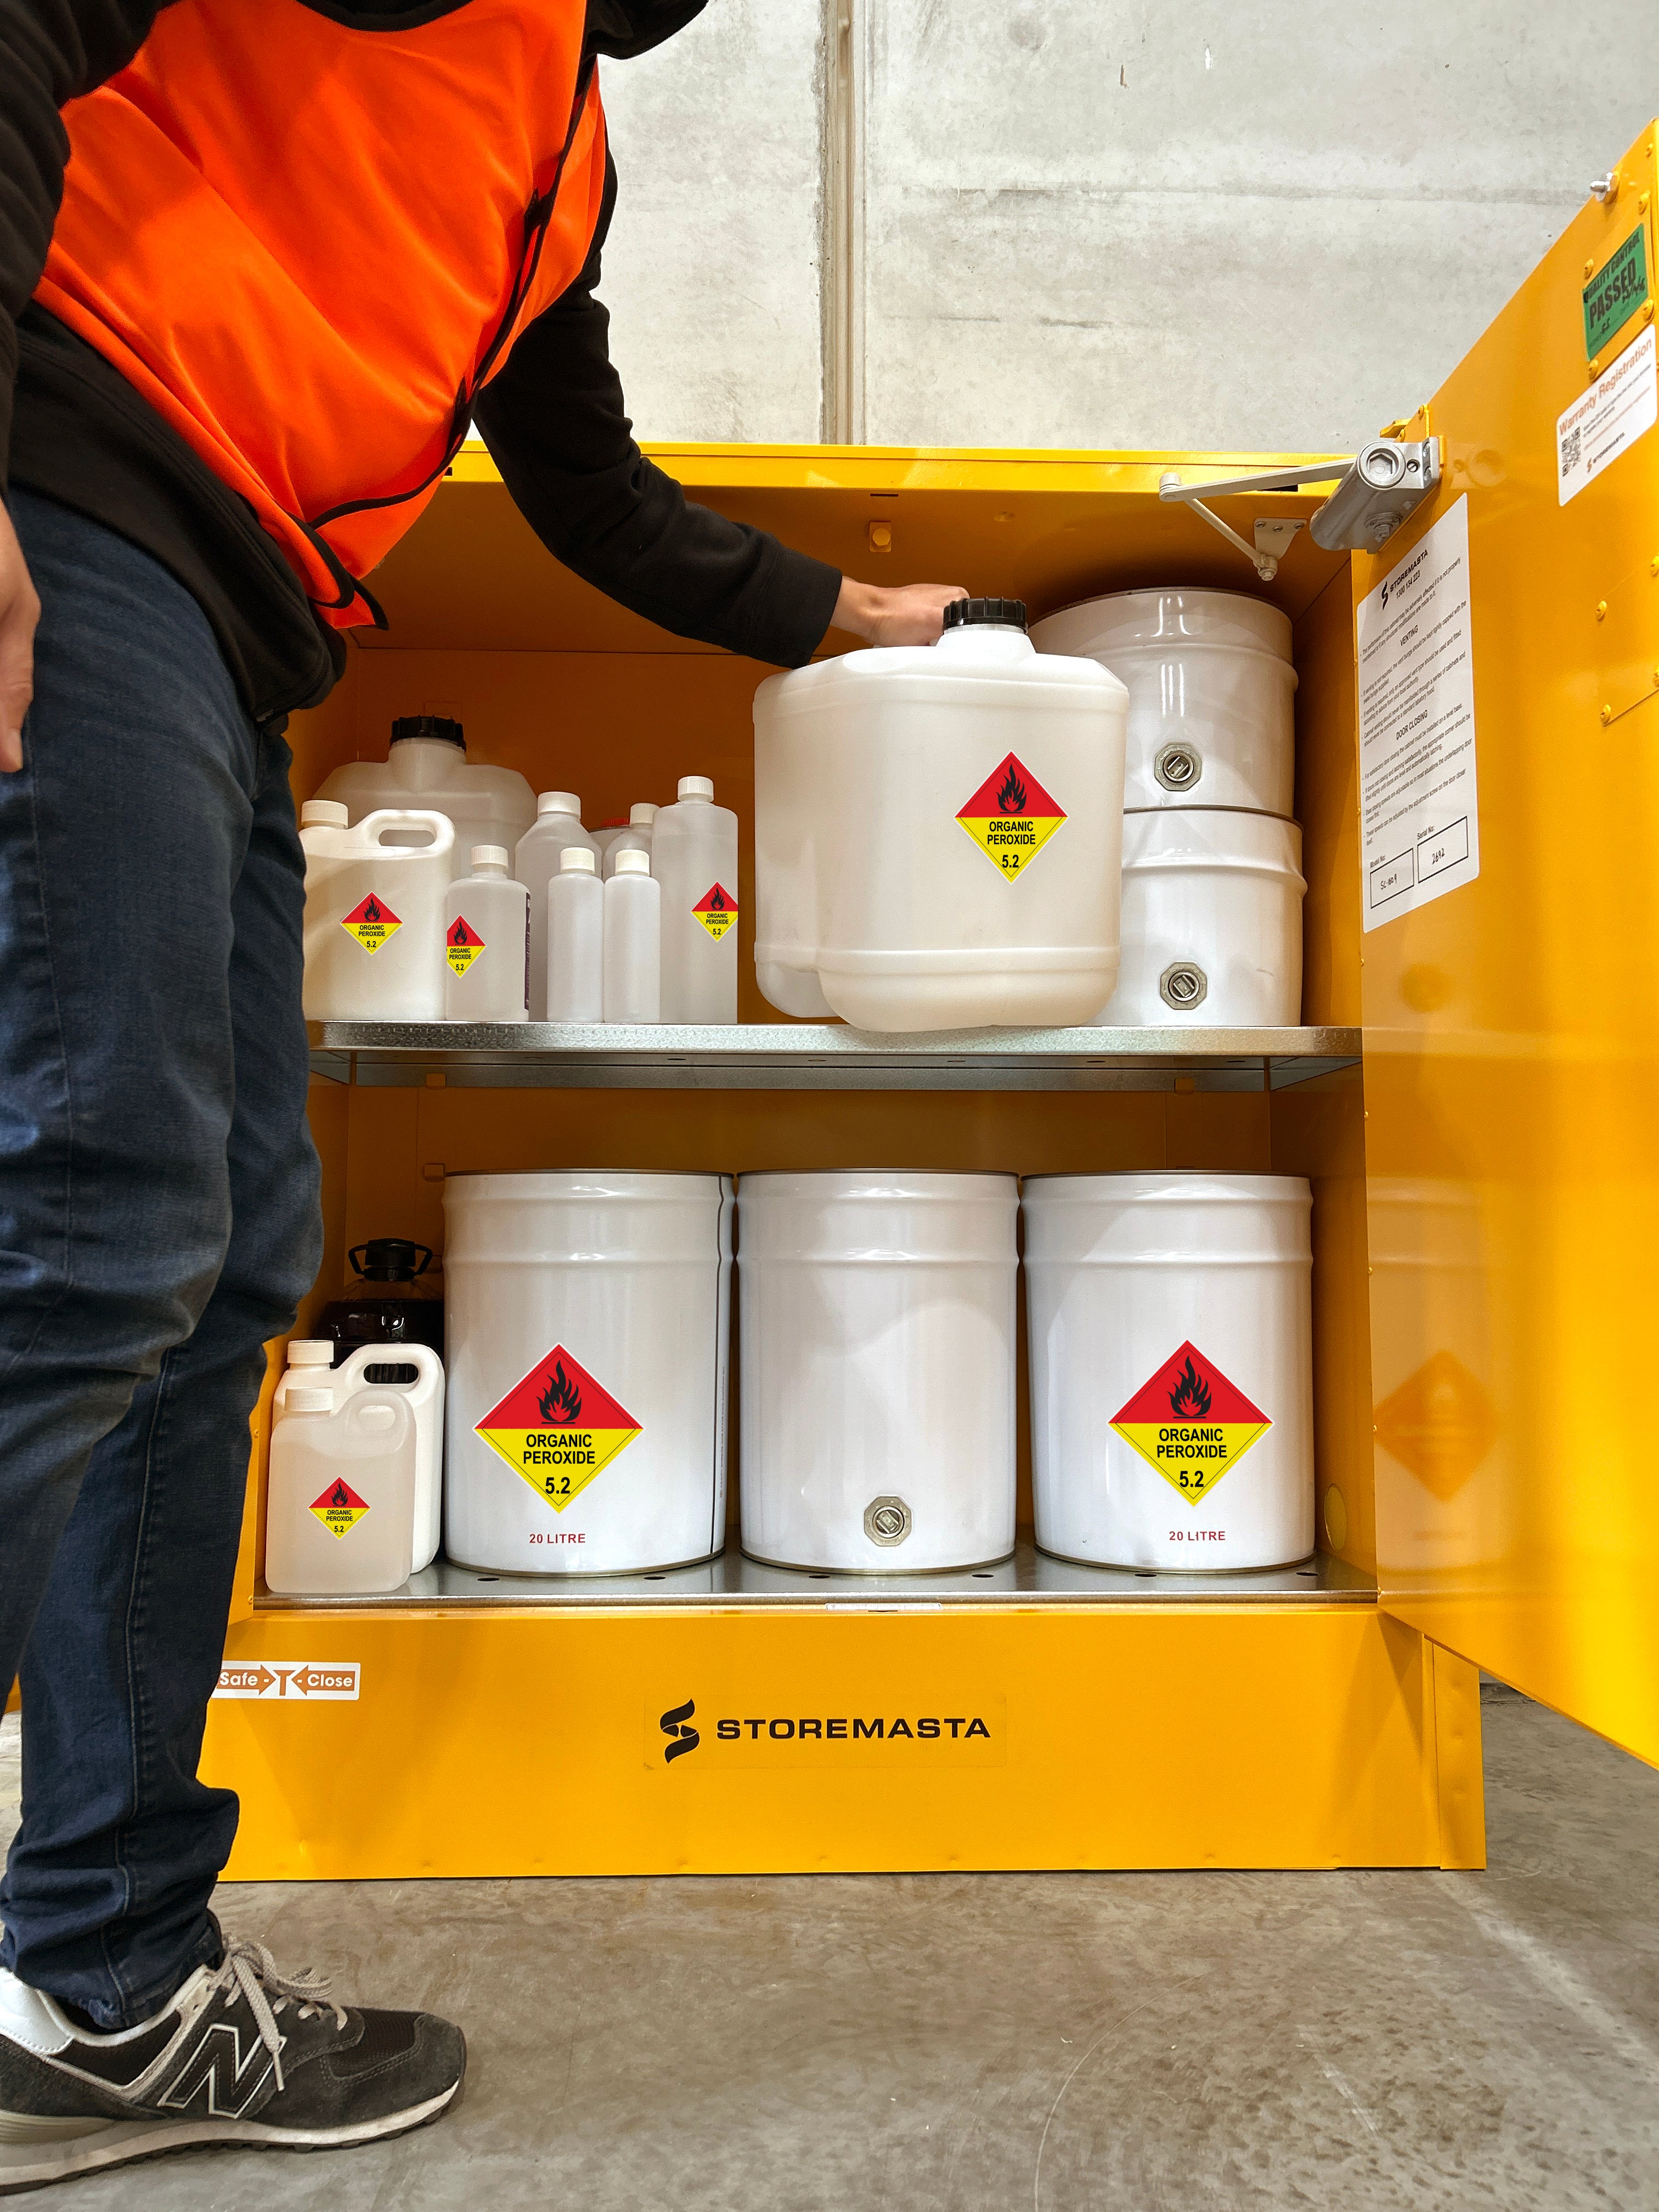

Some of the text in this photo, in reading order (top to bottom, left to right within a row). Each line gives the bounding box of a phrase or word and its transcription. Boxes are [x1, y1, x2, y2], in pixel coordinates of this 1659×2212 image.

[1611, 232, 1640, 274] CONTROL
[1589, 257, 1636, 328] PASSED
[1559, 392, 1596, 436] Warranty
[1599, 338, 1652, 399] Registration
[1390, 548, 1427, 593] STOREMASTA
[1396, 584, 1405, 600] 1300
[1400, 624, 1418, 647] VENTING
[1396, 708, 1427, 741] DOOR CLOSING
[990, 821, 1033, 832] ORGANIC
[1417, 827, 1428, 840] Serial
[988, 834, 1035, 844] PEROXIDE
[1002, 855, 1019, 868] 5.2
[527, 1435, 591, 1447] ORGANIC
[1159, 1429, 1223, 1441] ORGANIC
[524, 1451, 595, 1464] PEROXIDE
[1157, 1445, 1227, 1458] PEROXIDE
[545, 1477, 571, 1494] 5.2
[1180, 1471, 1204, 1487] 5.2
[529, 1533, 585, 1543] 20 LITRE
[1169, 1531, 1225, 1541] 20 LITRE
[219, 1673, 258, 1686] Safe
[307, 1674, 352, 1687] Close
[717, 1718, 990, 1739] STOREMASTA
[157, 2023, 288, 2120] N
